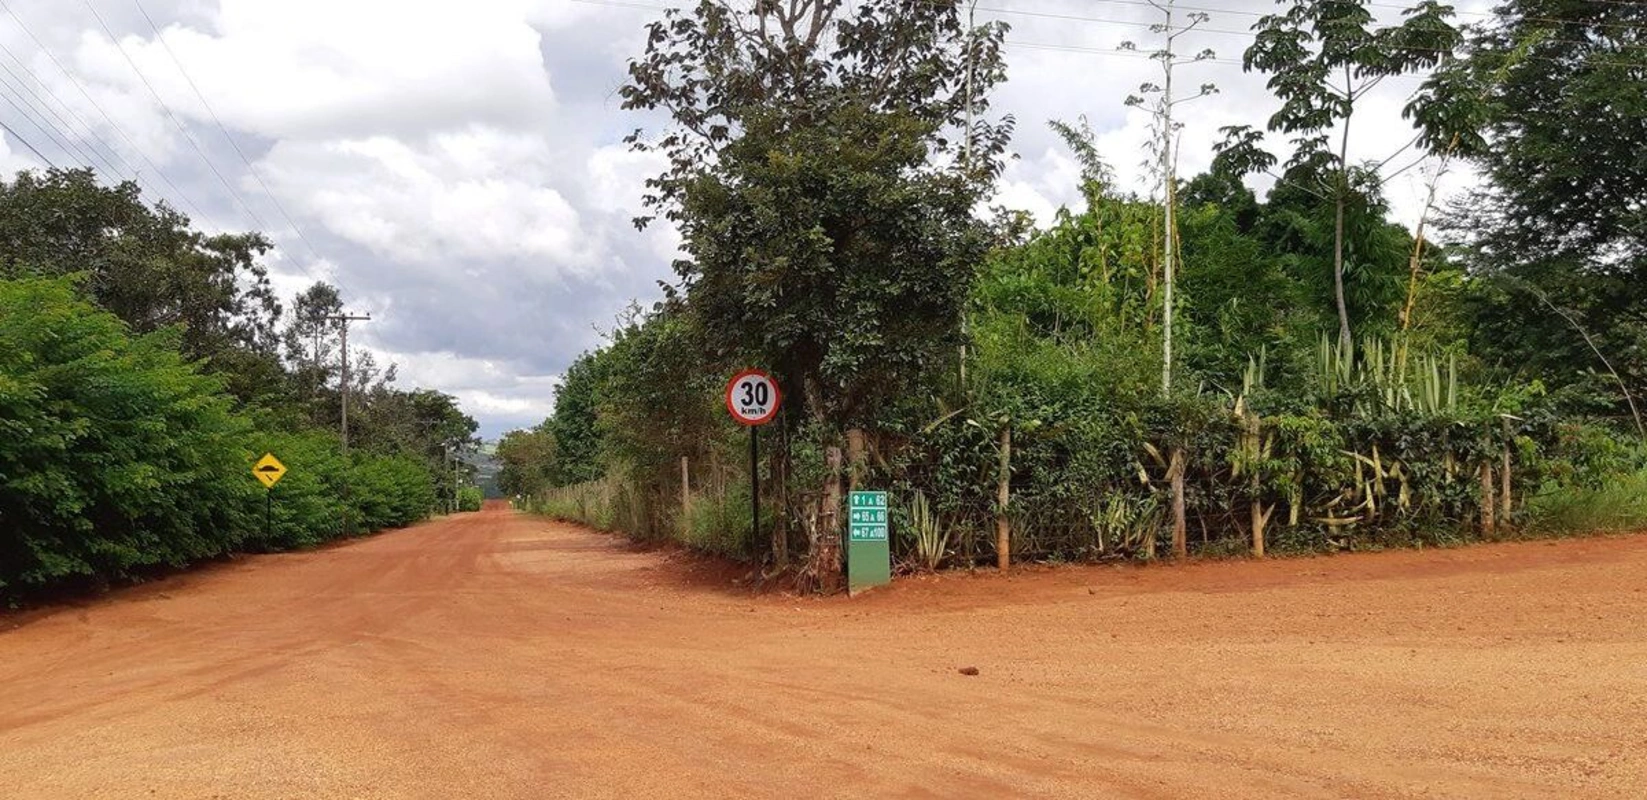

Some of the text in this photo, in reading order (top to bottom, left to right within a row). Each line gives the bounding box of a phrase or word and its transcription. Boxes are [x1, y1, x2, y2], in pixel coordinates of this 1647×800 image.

[741, 381, 768, 406] 30
[861, 495, 866, 505] 1
[876, 495, 885, 505] 62
[861, 511, 870, 522] 65
[861, 527, 869, 538] 67
